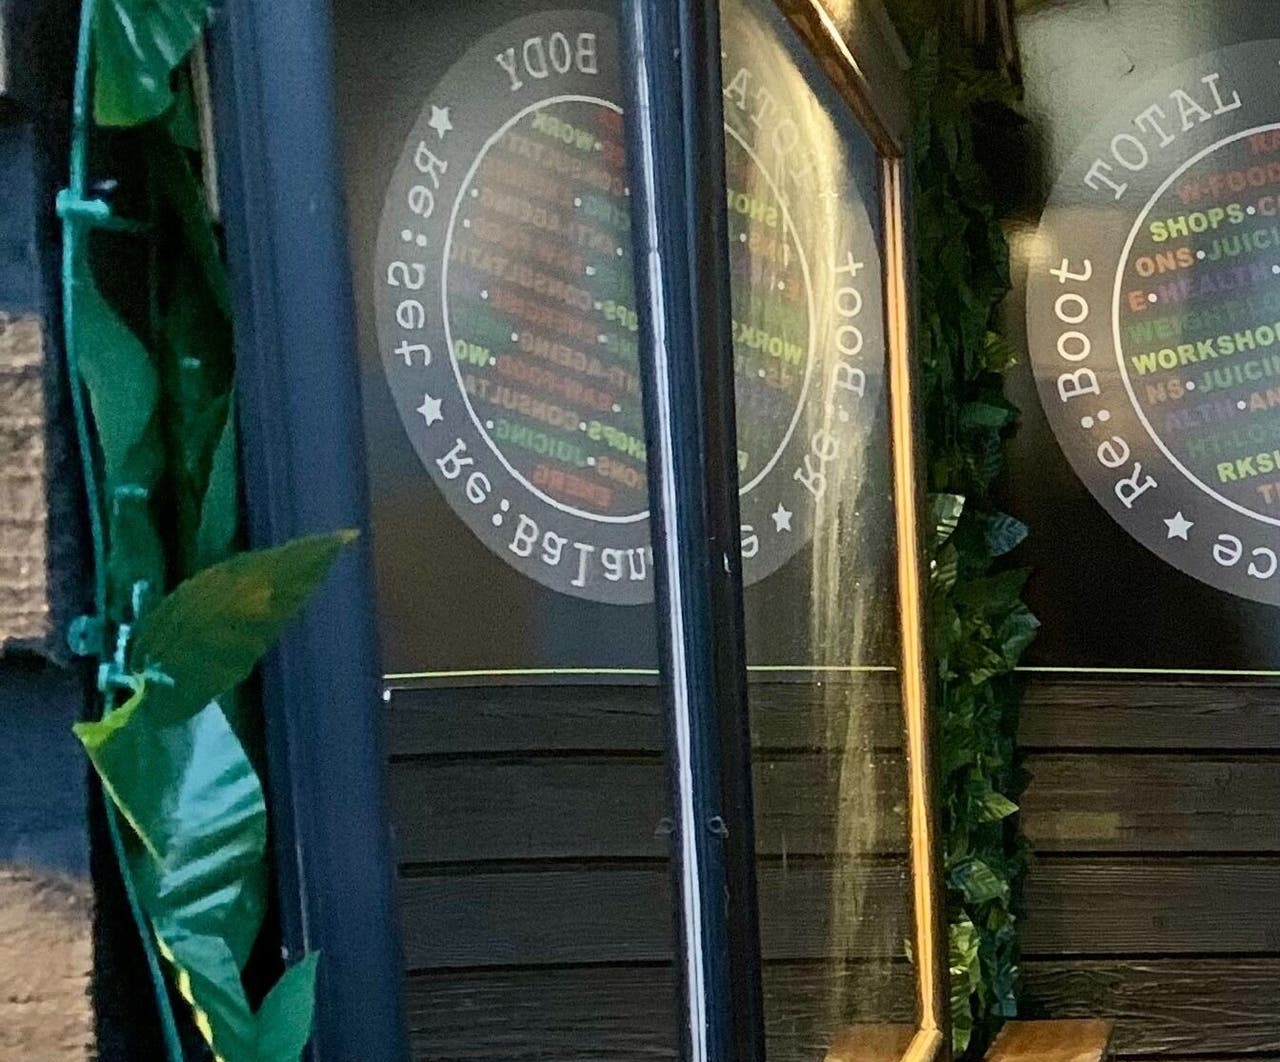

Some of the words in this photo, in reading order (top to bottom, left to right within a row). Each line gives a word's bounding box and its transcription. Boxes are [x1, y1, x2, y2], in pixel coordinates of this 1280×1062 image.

[1083, 72, 1243, 201] TOTAL
[1149, 202, 1245, 242] SHOPS
[1135, 247, 1195, 278] ONS
[1126, 289, 1148, 314] E
[1049, 257, 1158, 509] Re:Boot
[1144, 378, 1186, 406] NS
